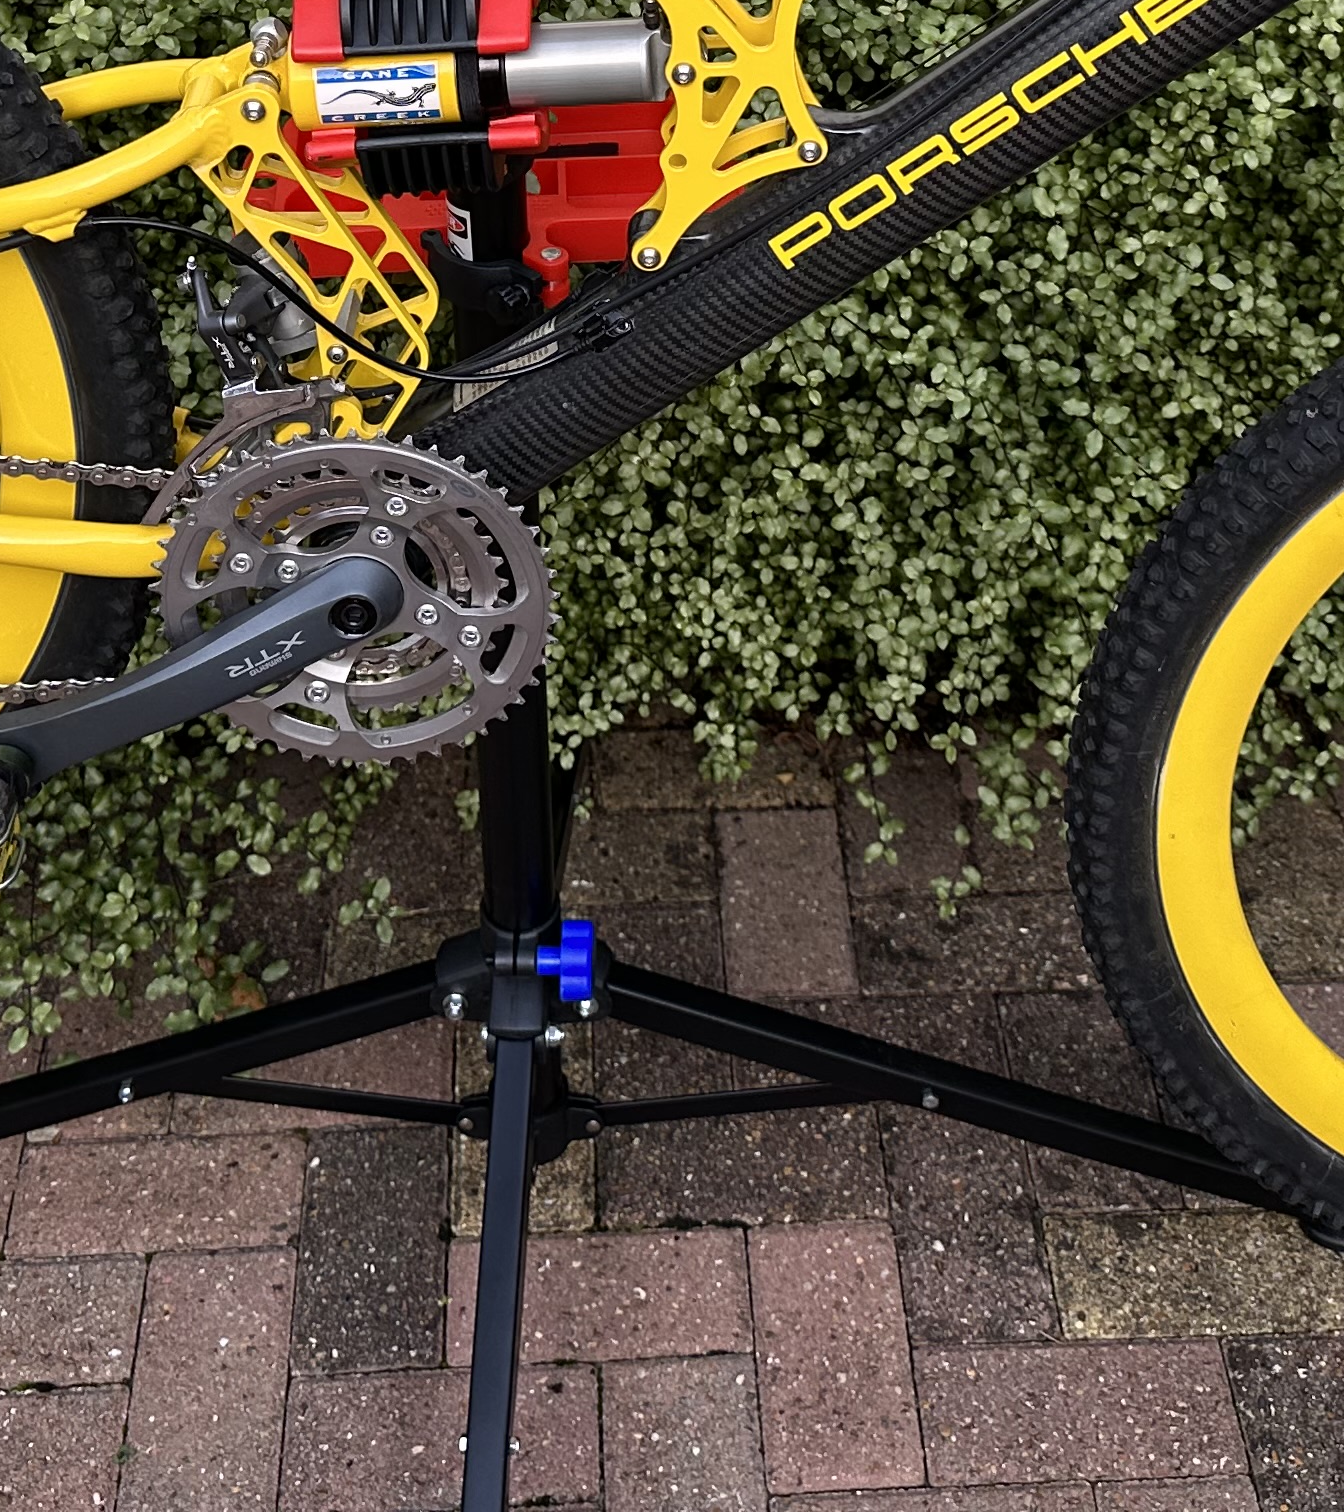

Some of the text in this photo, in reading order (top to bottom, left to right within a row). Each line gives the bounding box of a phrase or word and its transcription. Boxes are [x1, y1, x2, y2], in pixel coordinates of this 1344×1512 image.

[342, 68, 409, 80] CANE
[331, 110, 430, 122] CREEK
[224, 630, 305, 678] XTR
